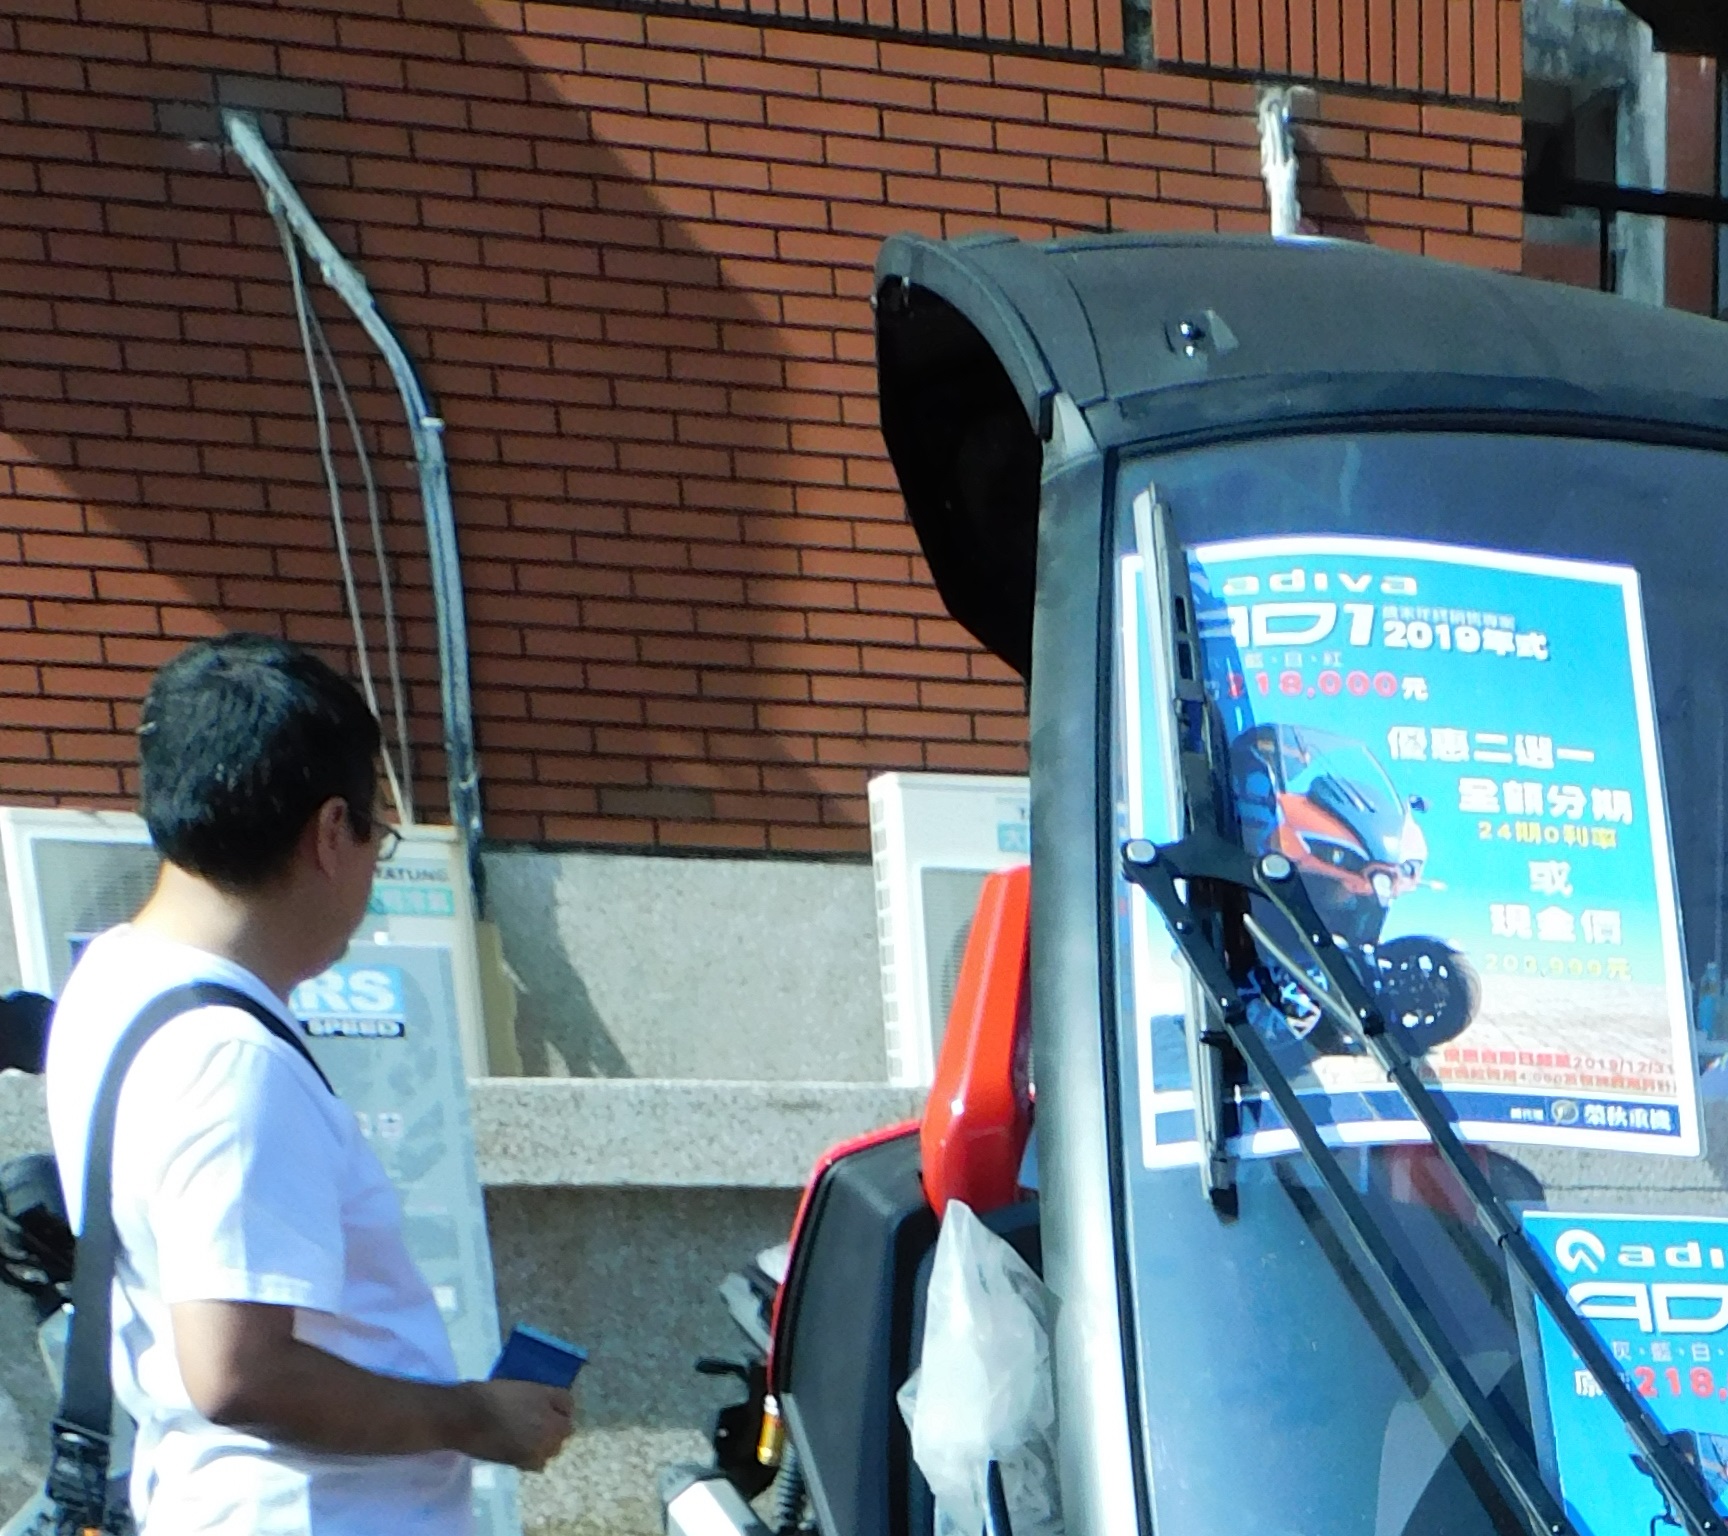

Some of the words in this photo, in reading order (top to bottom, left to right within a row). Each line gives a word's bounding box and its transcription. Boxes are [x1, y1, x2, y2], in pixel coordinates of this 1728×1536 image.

[1222, 568, 1418, 596] adiva
[1383, 620, 1550, 661] 2019年式
[1387, 726, 1595, 769] 優惠二選一
